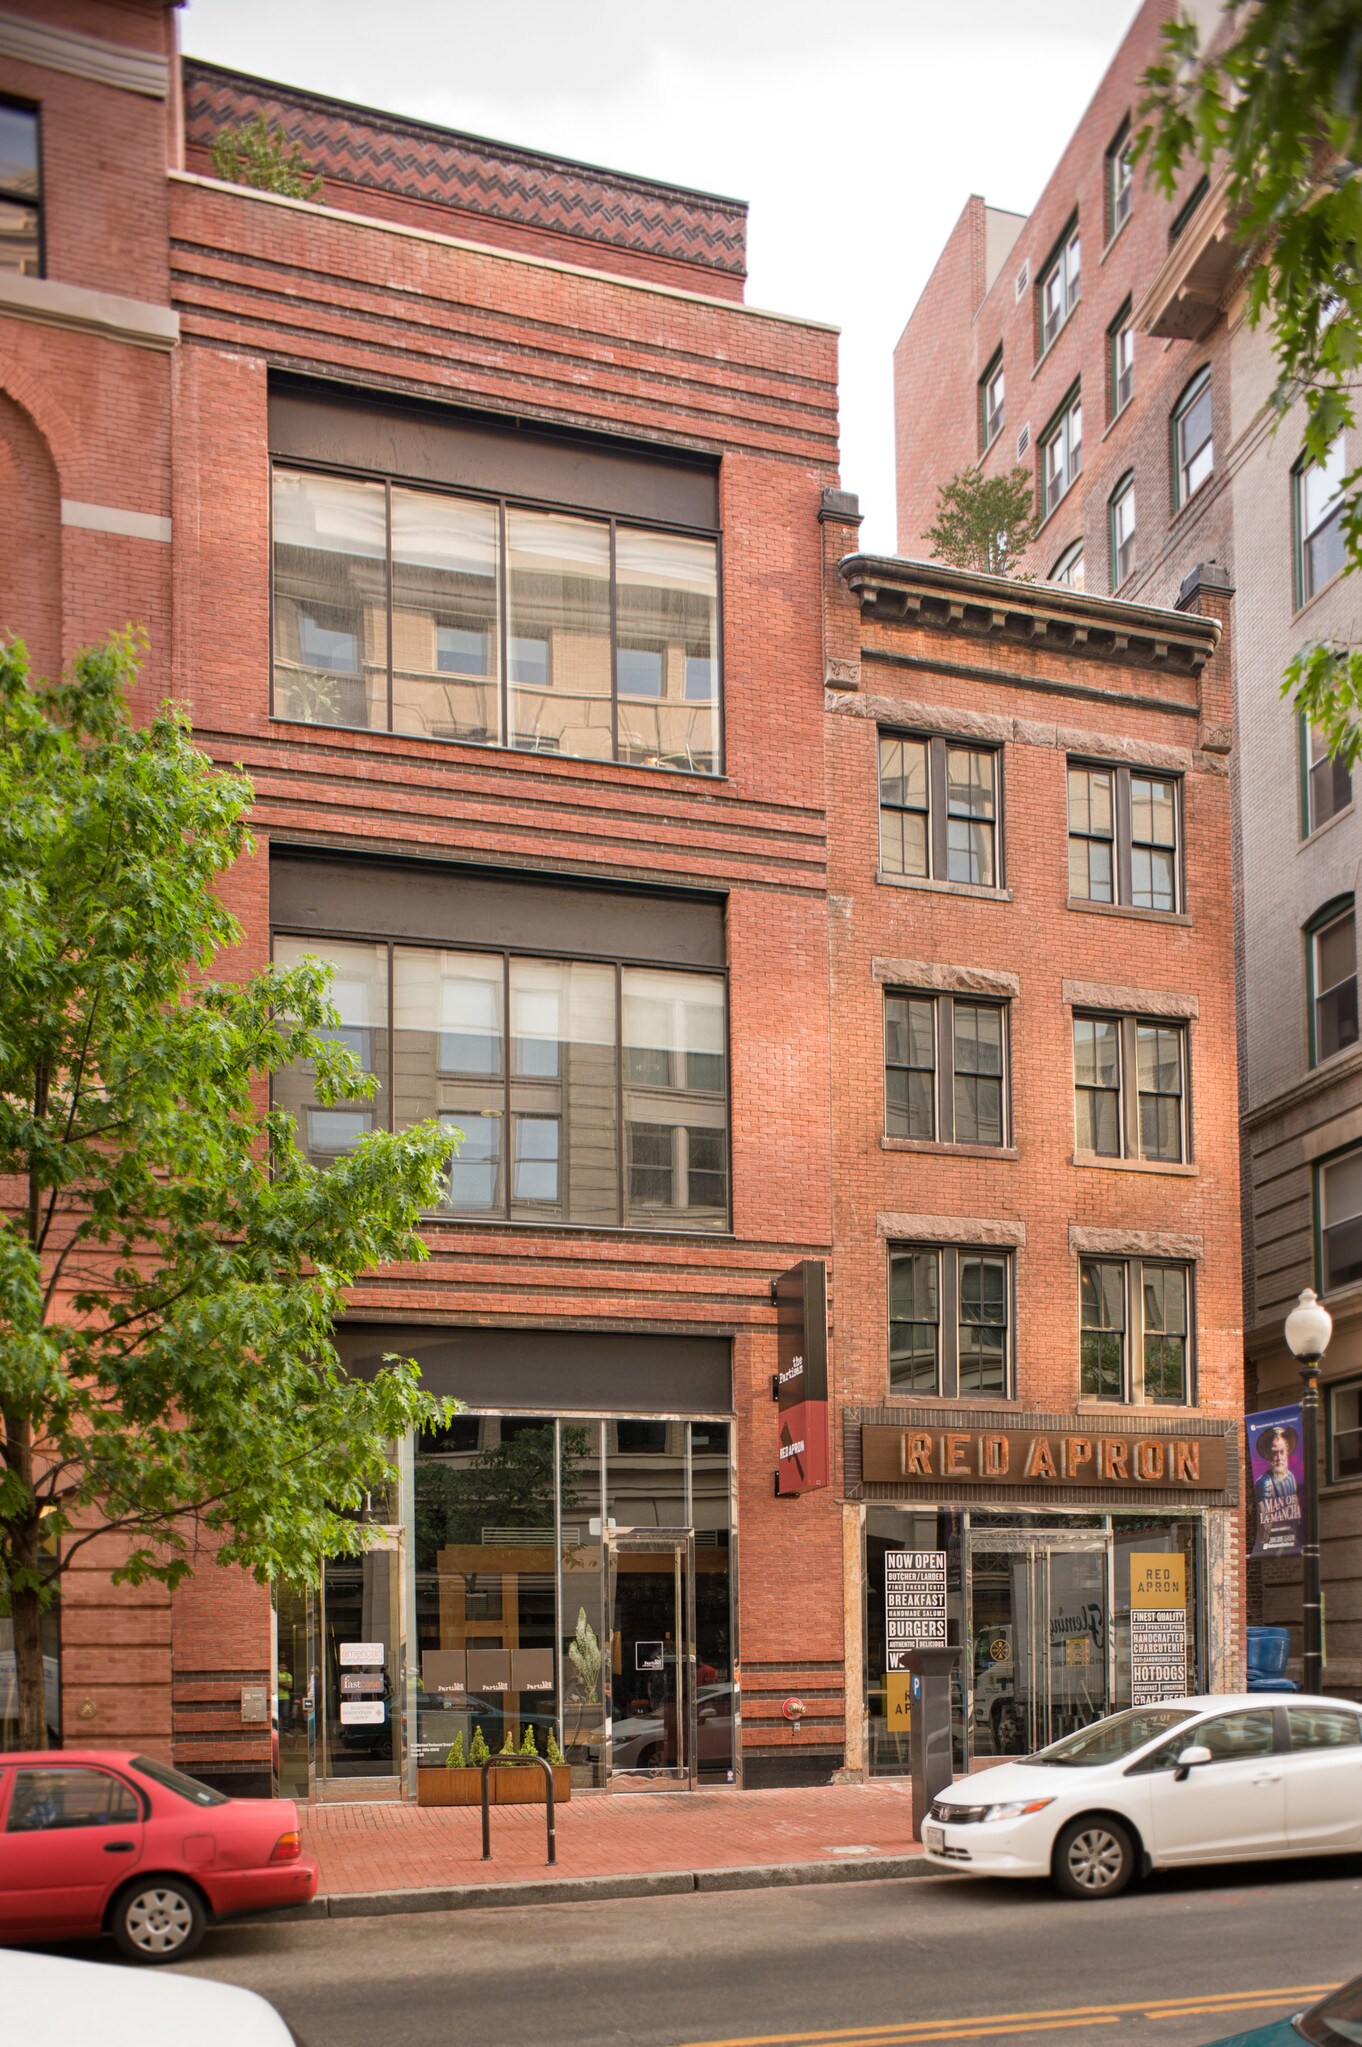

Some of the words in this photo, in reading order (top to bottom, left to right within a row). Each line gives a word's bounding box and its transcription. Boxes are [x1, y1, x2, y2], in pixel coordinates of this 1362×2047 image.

[792, 1356, 803, 1368] the
[779, 1365, 804, 1384] Partisan
[780, 1446, 789, 1460] RED
[788, 1440, 804, 1456] APRON
[902, 1432, 1009, 1476] RED
[1025, 1436, 1199, 1480] APRON
[888, 1554, 912, 1568] NOW
[915, 1554, 943, 1568] OPEN
[1146, 1569, 1170, 1579] RED
[1138, 1582, 1179, 1592] APRON
[888, 1594, 943, 1606] BREAKFAST
[1133, 1612, 1156, 1621] FINEST
[1157, 1612, 1183, 1621] QUALITY
[889, 1621, 944, 1636] BURGERS
[1134, 1633, 1184, 1643] HANDCRAFTED
[1134, 1643, 1184, 1653] CHARCUTERIE
[1134, 1666, 1184, 1681] HOTDOGS
[344, 1676, 381, 1688] fastcase
[914, 1678, 920, 1695] P
[1134, 1695, 1160, 1704] CRAFT
